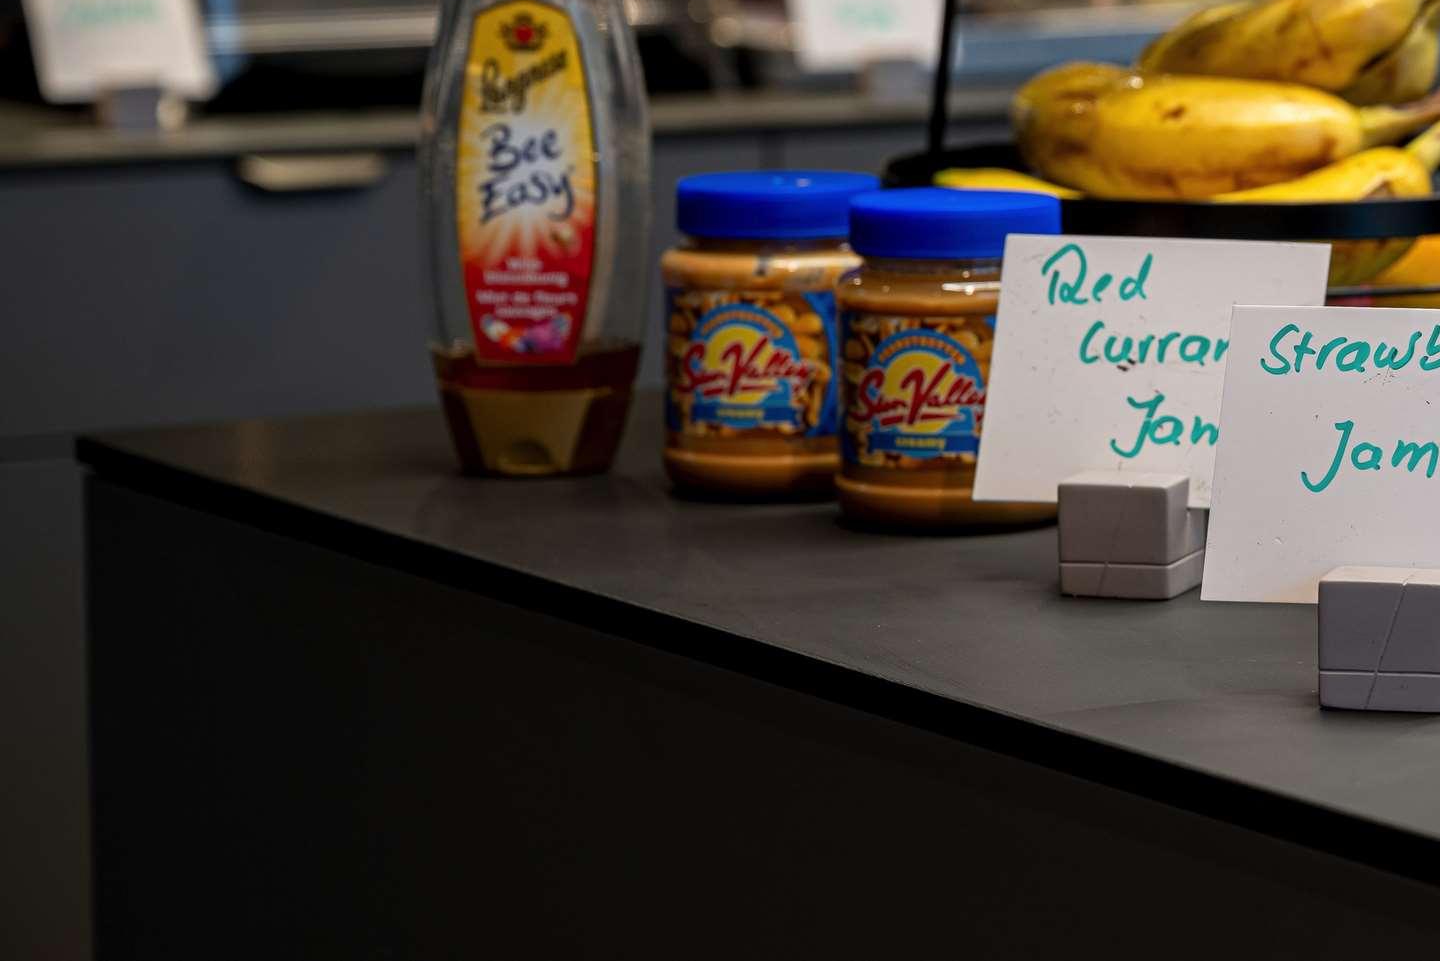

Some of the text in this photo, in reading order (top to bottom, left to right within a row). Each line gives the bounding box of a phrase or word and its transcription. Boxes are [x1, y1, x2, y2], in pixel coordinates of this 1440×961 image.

[481, 124, 562, 173] Bee
[478, 172, 575, 224] Easy
[1041, 243, 1153, 305] Red
[1300, 420, 1440, 493] Jam
